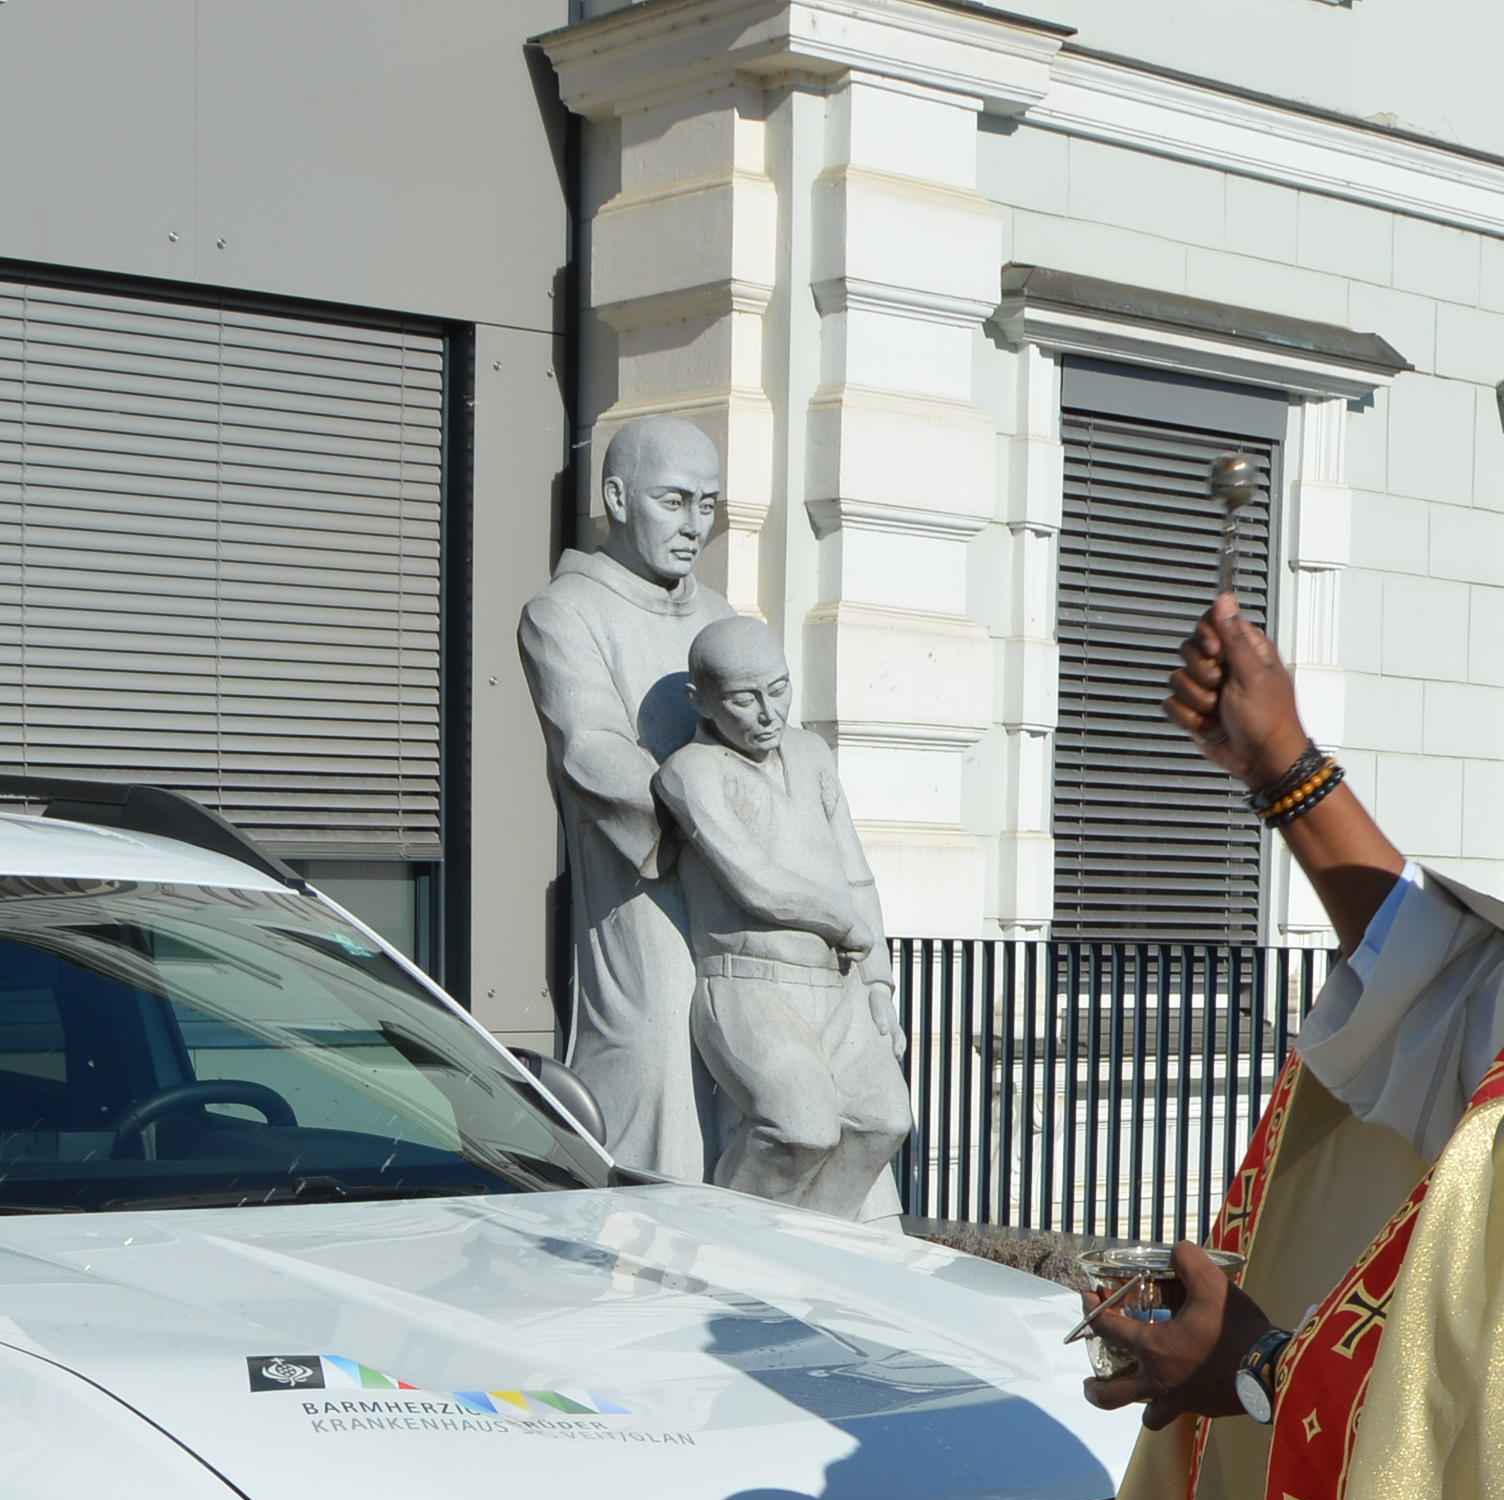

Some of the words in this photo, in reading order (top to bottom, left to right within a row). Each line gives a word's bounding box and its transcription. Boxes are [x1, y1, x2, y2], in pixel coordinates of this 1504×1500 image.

[302, 1401, 481, 1416] BARMHERZI
[507, 1418, 609, 1430] RÜDER
[311, 1417, 509, 1434] KRANKENHAUS
